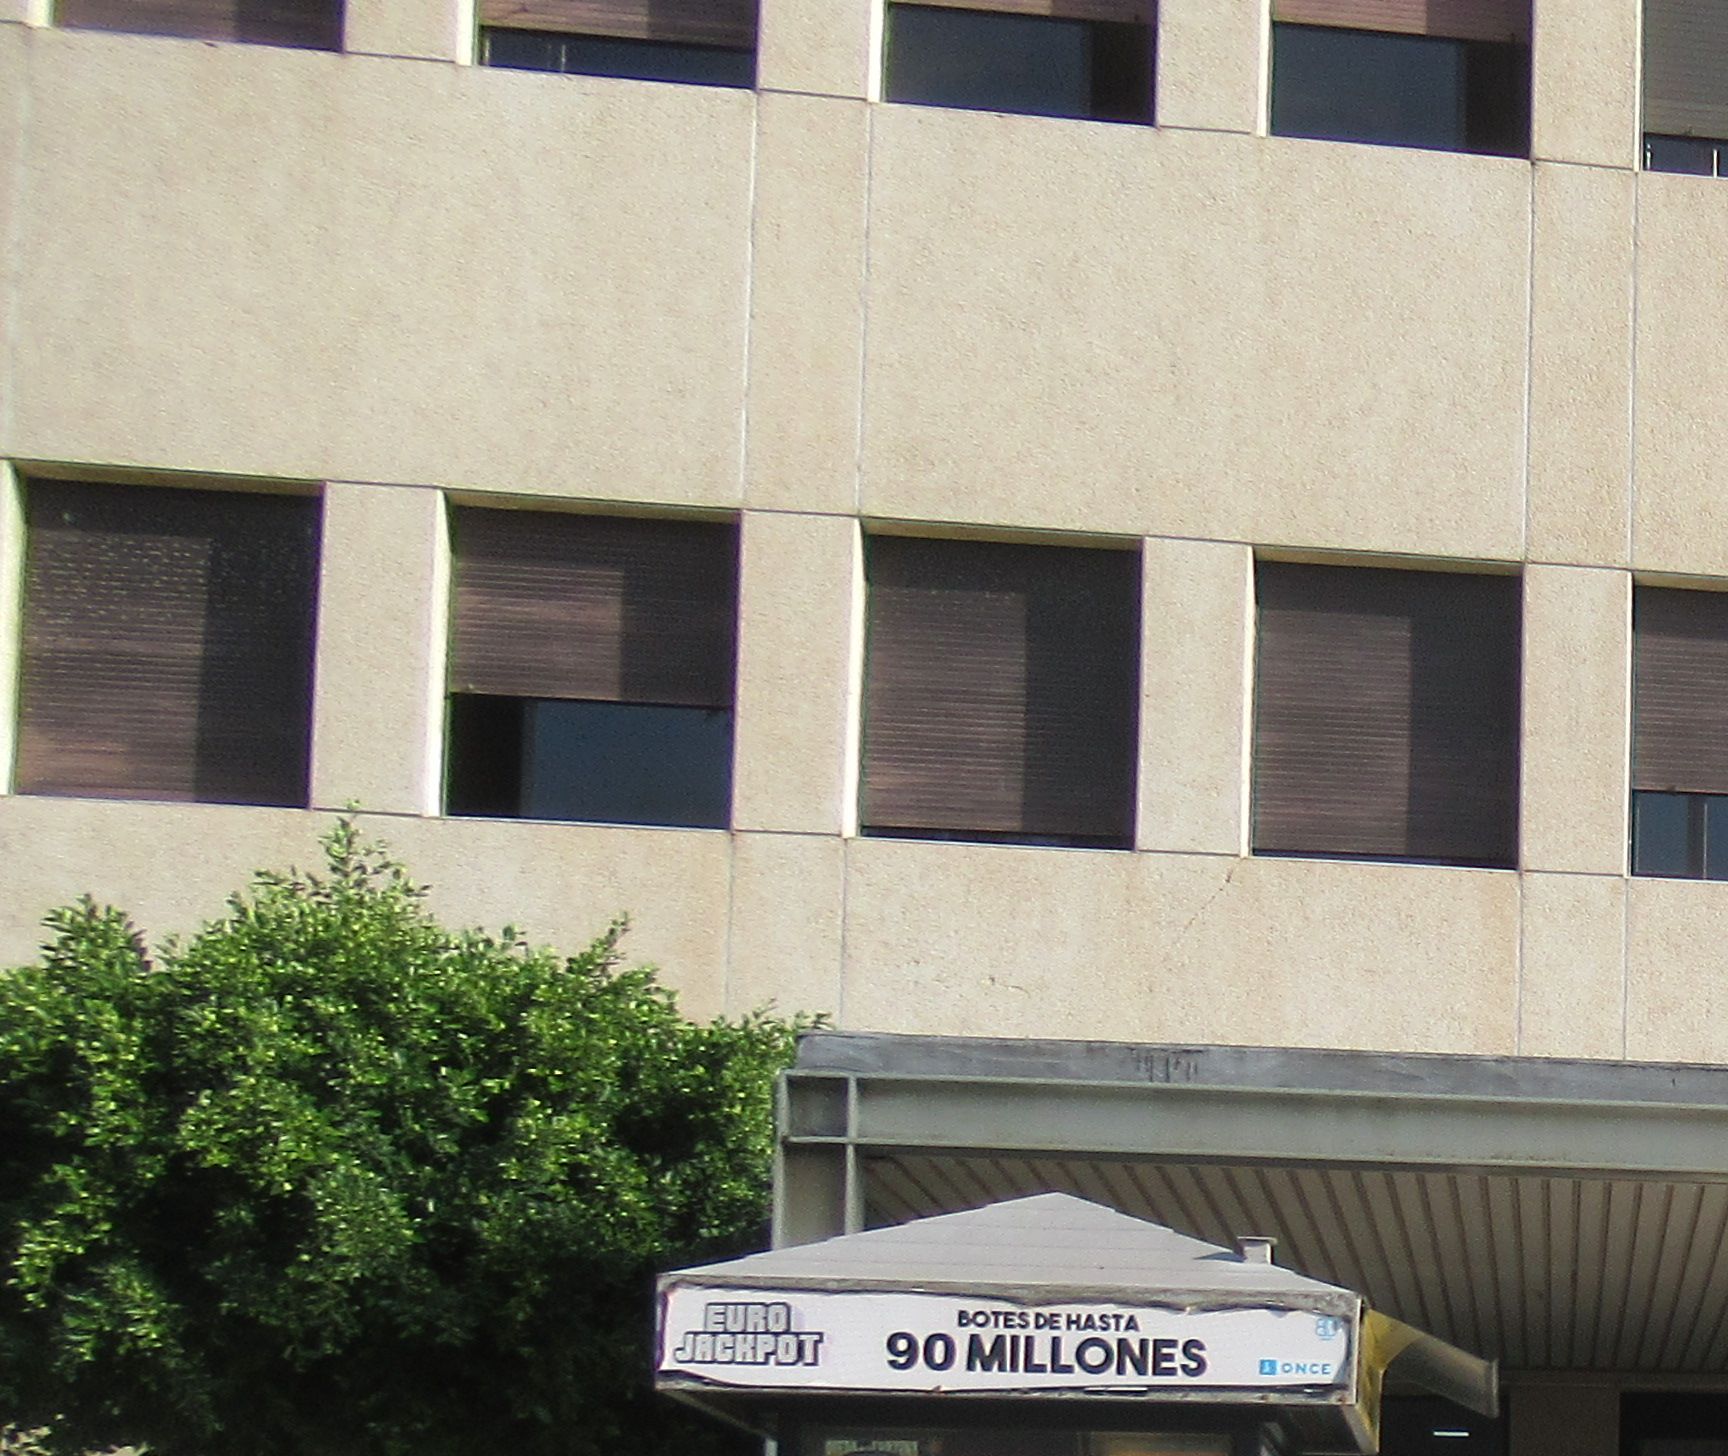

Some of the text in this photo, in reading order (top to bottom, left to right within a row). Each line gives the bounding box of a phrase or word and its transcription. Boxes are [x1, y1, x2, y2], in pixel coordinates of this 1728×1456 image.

[704, 1303, 790, 1333] EURO
[957, 1310, 1141, 1333] BOTES DE HASTA
[674, 1332, 823, 1366] JACKPOT
[886, 1331, 1208, 1377] 90 MILLONES
[1280, 1362, 1331, 1375] ONCE
